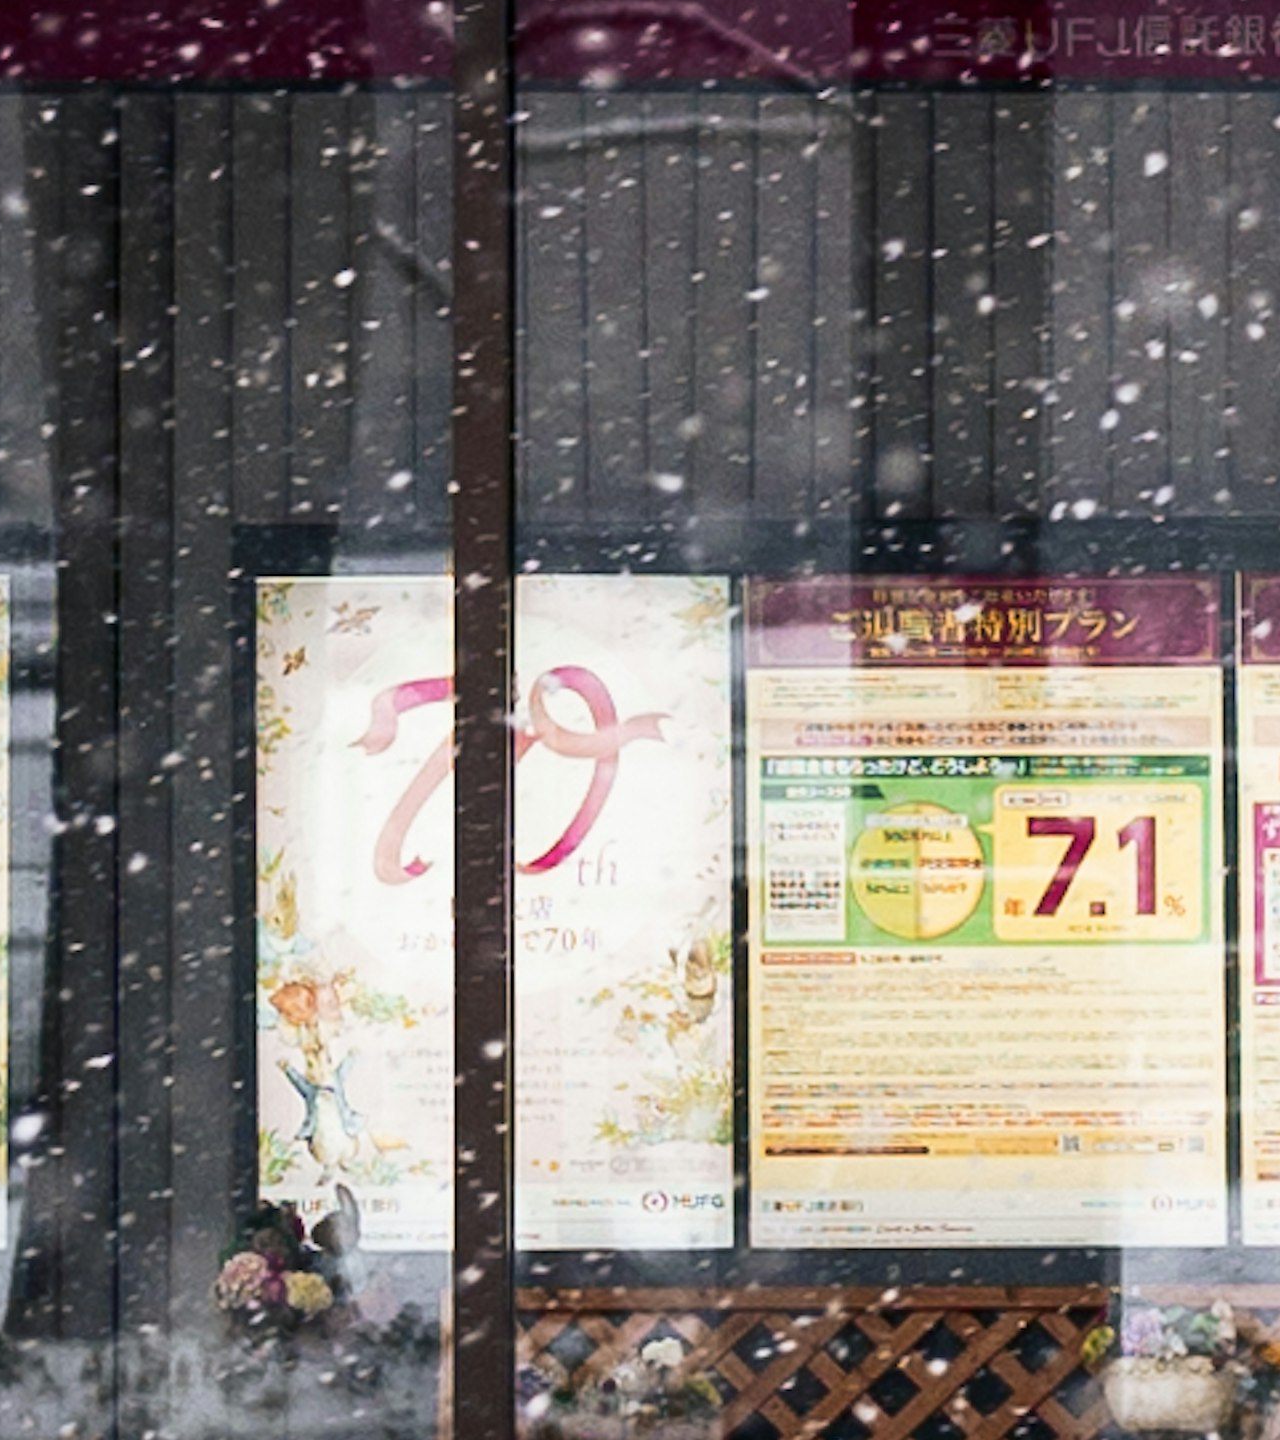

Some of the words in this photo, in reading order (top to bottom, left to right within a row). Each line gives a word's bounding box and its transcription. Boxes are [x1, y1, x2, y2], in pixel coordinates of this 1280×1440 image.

[830, 608, 1140, 643] ご退職者特別プラン
[1026, 816, 1156, 917] 7.1
[672, 1194, 724, 1211] MUFG
